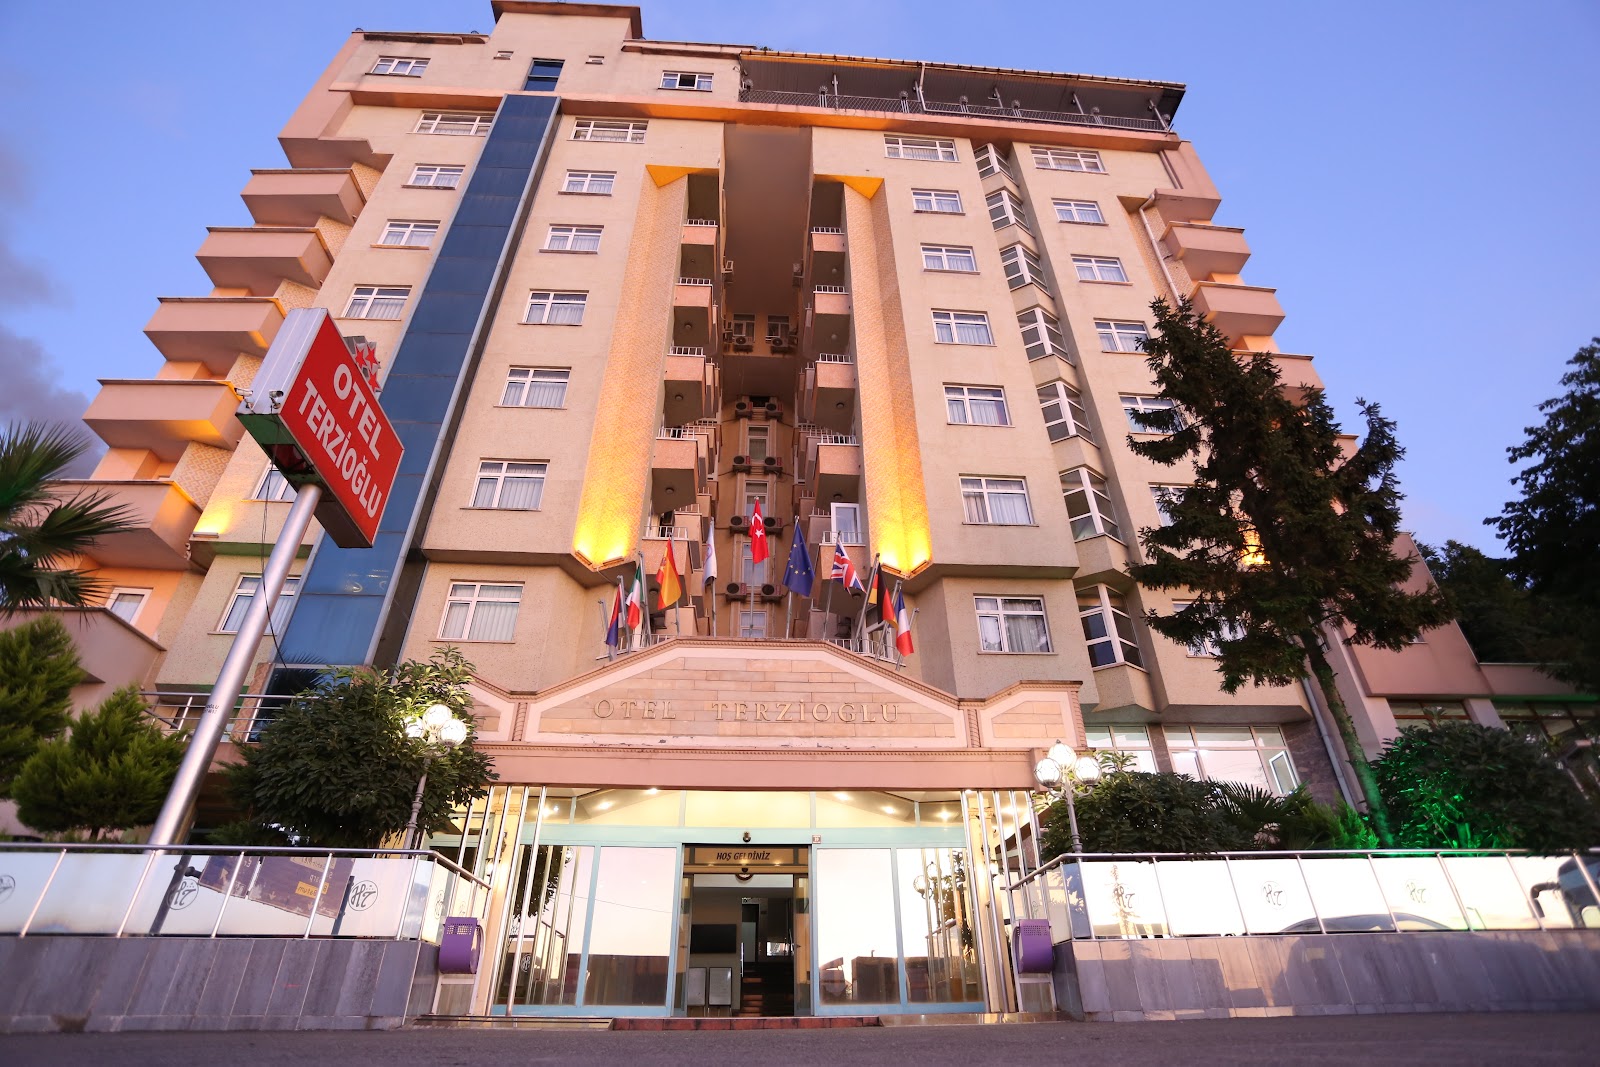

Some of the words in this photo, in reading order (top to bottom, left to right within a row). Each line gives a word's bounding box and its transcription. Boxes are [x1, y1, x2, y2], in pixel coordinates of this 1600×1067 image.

[333, 364, 382, 461] OTEL
[299, 378, 382, 518] TERZİOĞLU
[594, 699, 677, 720] OTEL
[716, 852, 732, 862] HOŞ
[733, 850, 771, 861] GELDİNİZ
